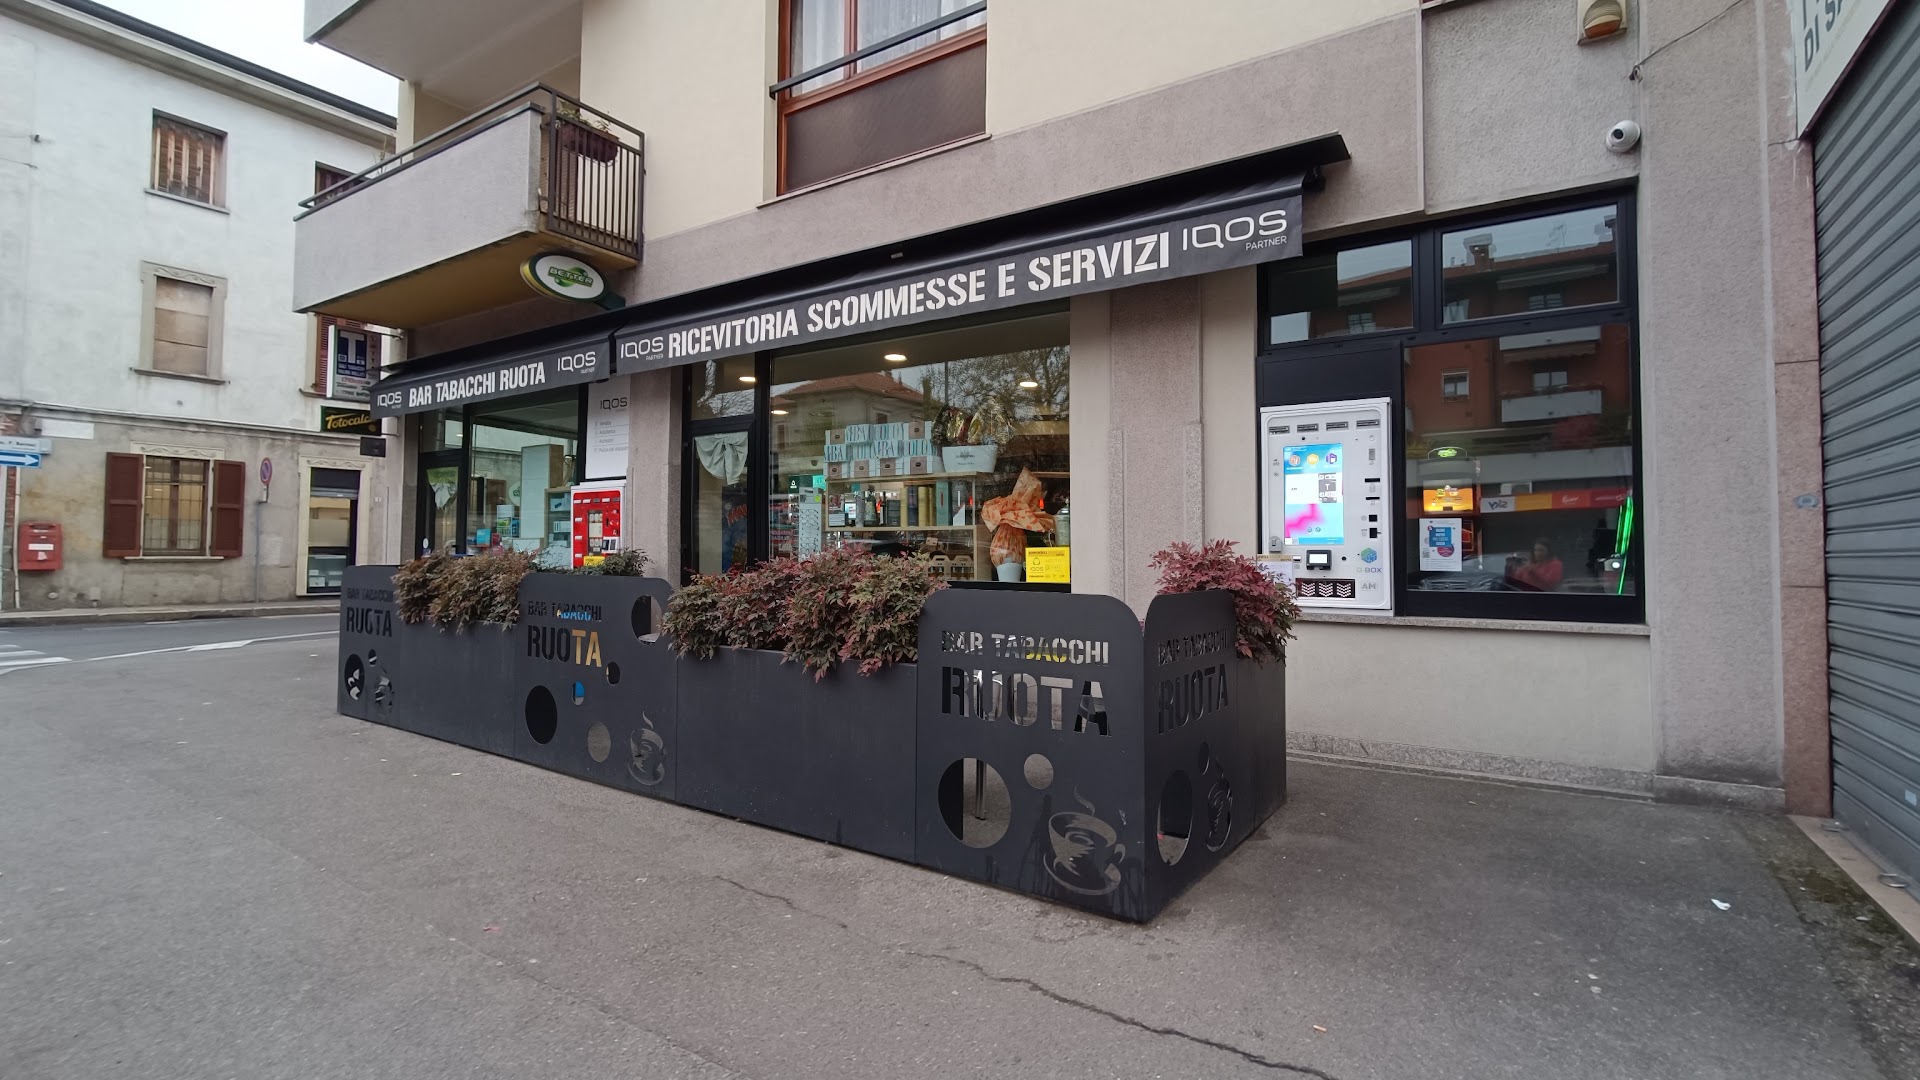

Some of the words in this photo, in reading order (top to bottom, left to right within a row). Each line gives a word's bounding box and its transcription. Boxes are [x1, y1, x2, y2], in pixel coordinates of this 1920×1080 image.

[1804, 13, 1820, 72] DI
[1825, 0, 1842, 32] S
[1182, 209, 1287, 251] IQOS
[1245, 235, 1287, 251] PARTNER
[548, 267, 593, 287] BETTER
[668, 308, 799, 359] RICEVITORIA
[807, 268, 986, 333] SCOMMESSE
[998, 262, 1016, 298] E
[1028, 231, 1169, 291] SERVIZI
[557, 351, 596, 372] IQOS
[620, 337, 664, 359] IQOS
[377, 391, 402, 408] IQOS
[408, 385, 432, 407] BAR
[435, 371, 496, 402] TABACCHI
[499, 361, 546, 391] RUOTA
[600, 397, 628, 410] IQOS
[347, 607, 392, 637] RUOTA
[528, 601, 547, 616] BAR
[550, 602, 602, 622] TABACCHI
[527, 625, 602, 668] RUOTA
[941, 630, 983, 656] BAR
[991, 633, 1109, 665] TABACCHI
[1158, 639, 1180, 666] BAR
[1183, 629, 1228, 659] TABACCHI
[942, 666, 1111, 737] RUOTA
[1159, 664, 1229, 735] RUOTA
